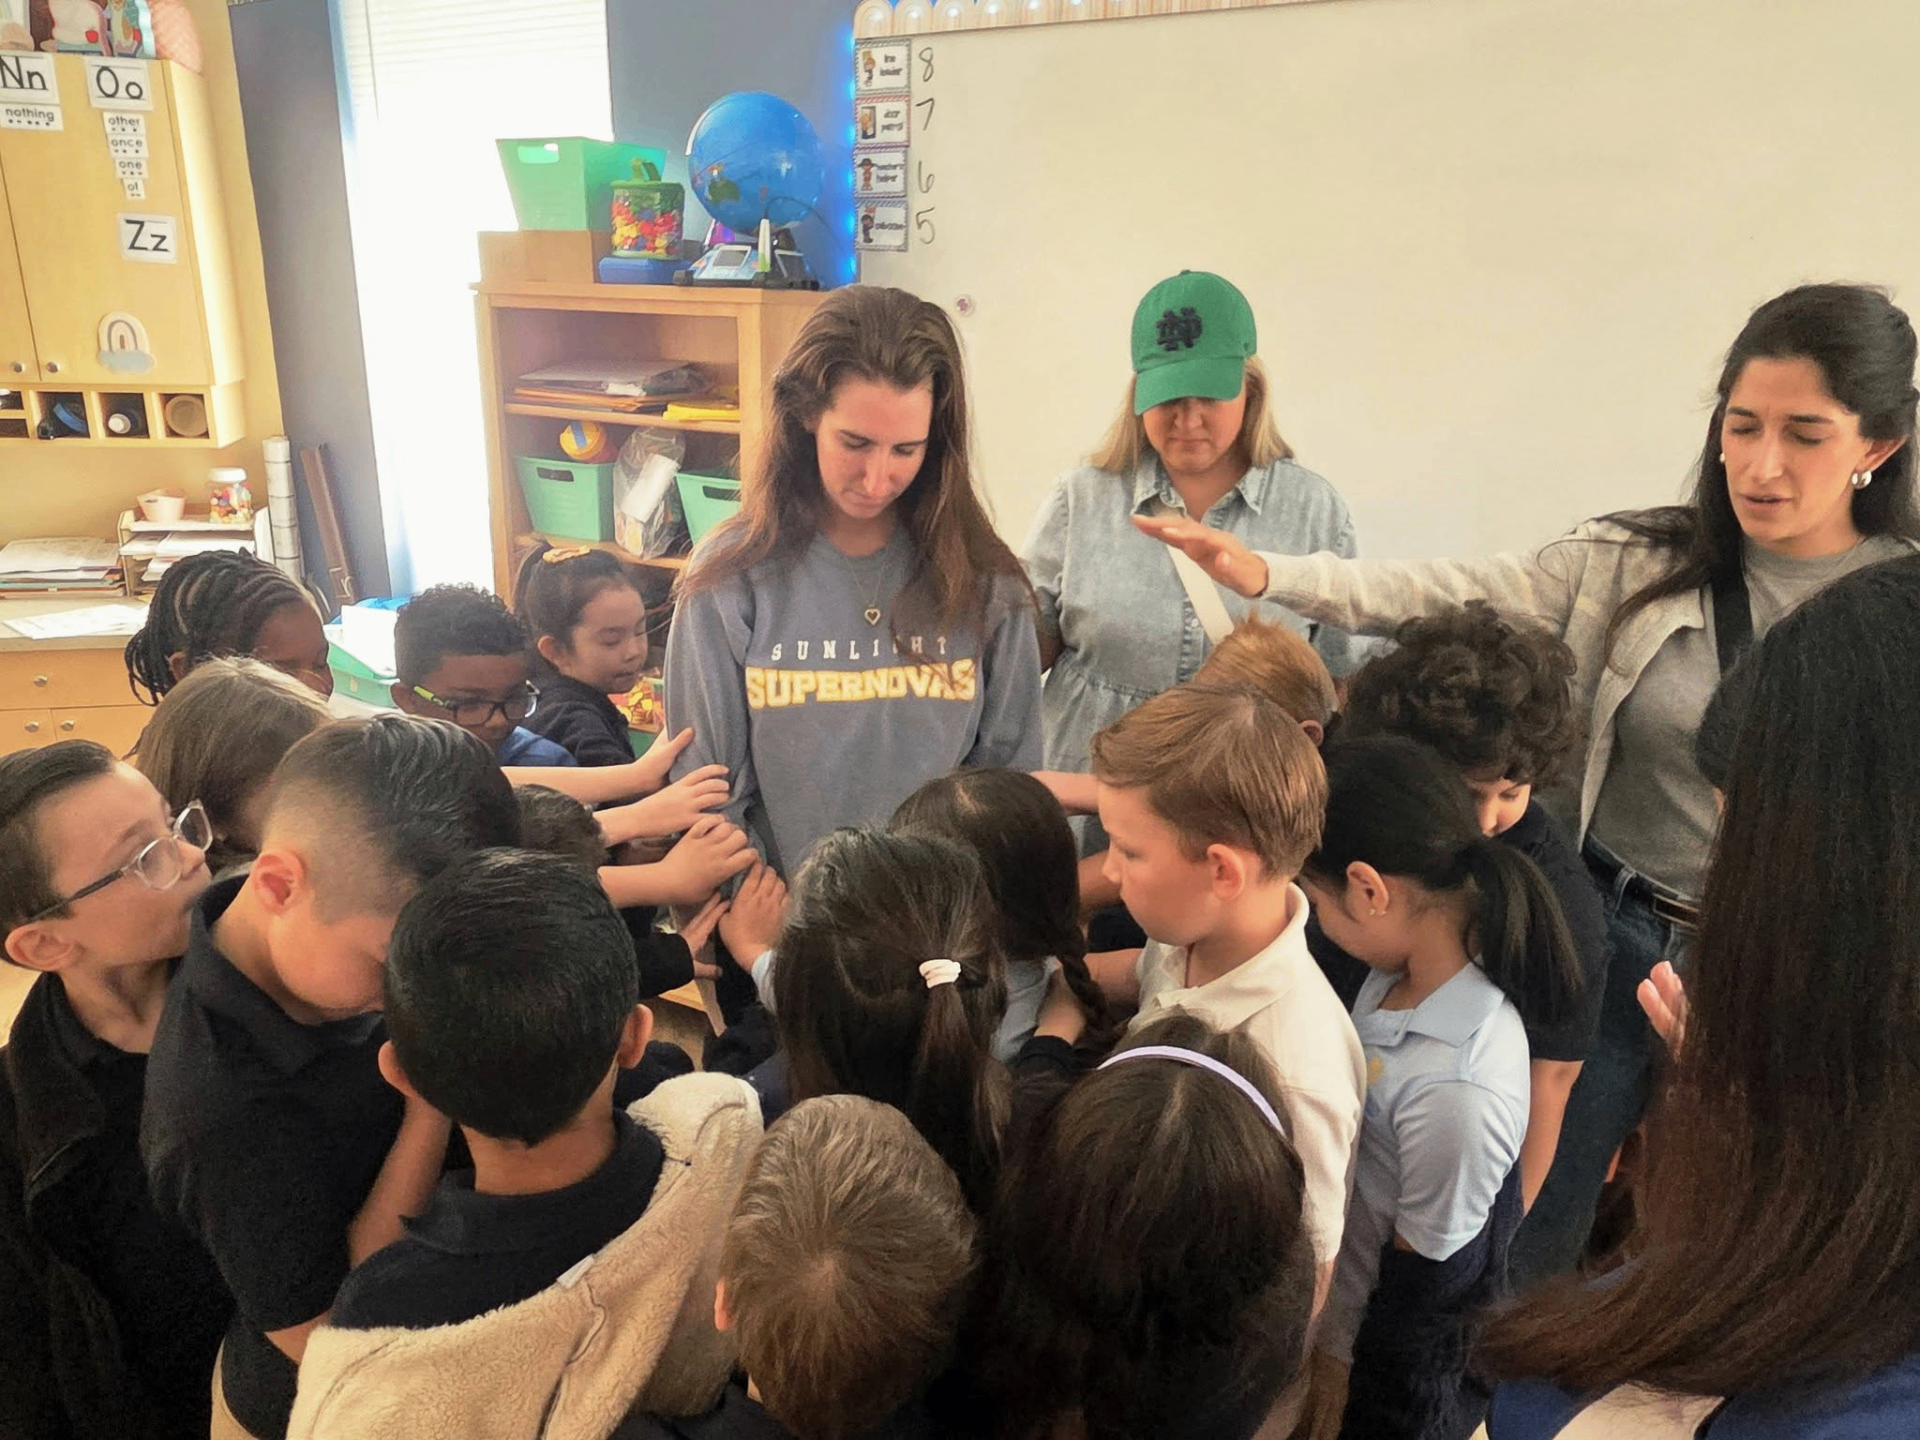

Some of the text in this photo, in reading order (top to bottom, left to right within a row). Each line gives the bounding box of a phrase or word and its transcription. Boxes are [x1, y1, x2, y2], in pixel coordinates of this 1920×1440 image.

[0, 55, 47, 90] Nn
[919, 47, 934, 83] 8
[96, 66, 143, 99] Oo
[5, 108, 55, 122] nothing
[108, 116, 140, 127] other
[915, 97, 935, 131] 7
[111, 137, 143, 148] once
[118, 160, 143, 170] one
[918, 160, 935, 194] 6
[124, 219, 170, 252] Zz
[915, 206, 936, 245] 5
[745, 658, 976, 710] SUPERNOVAS
